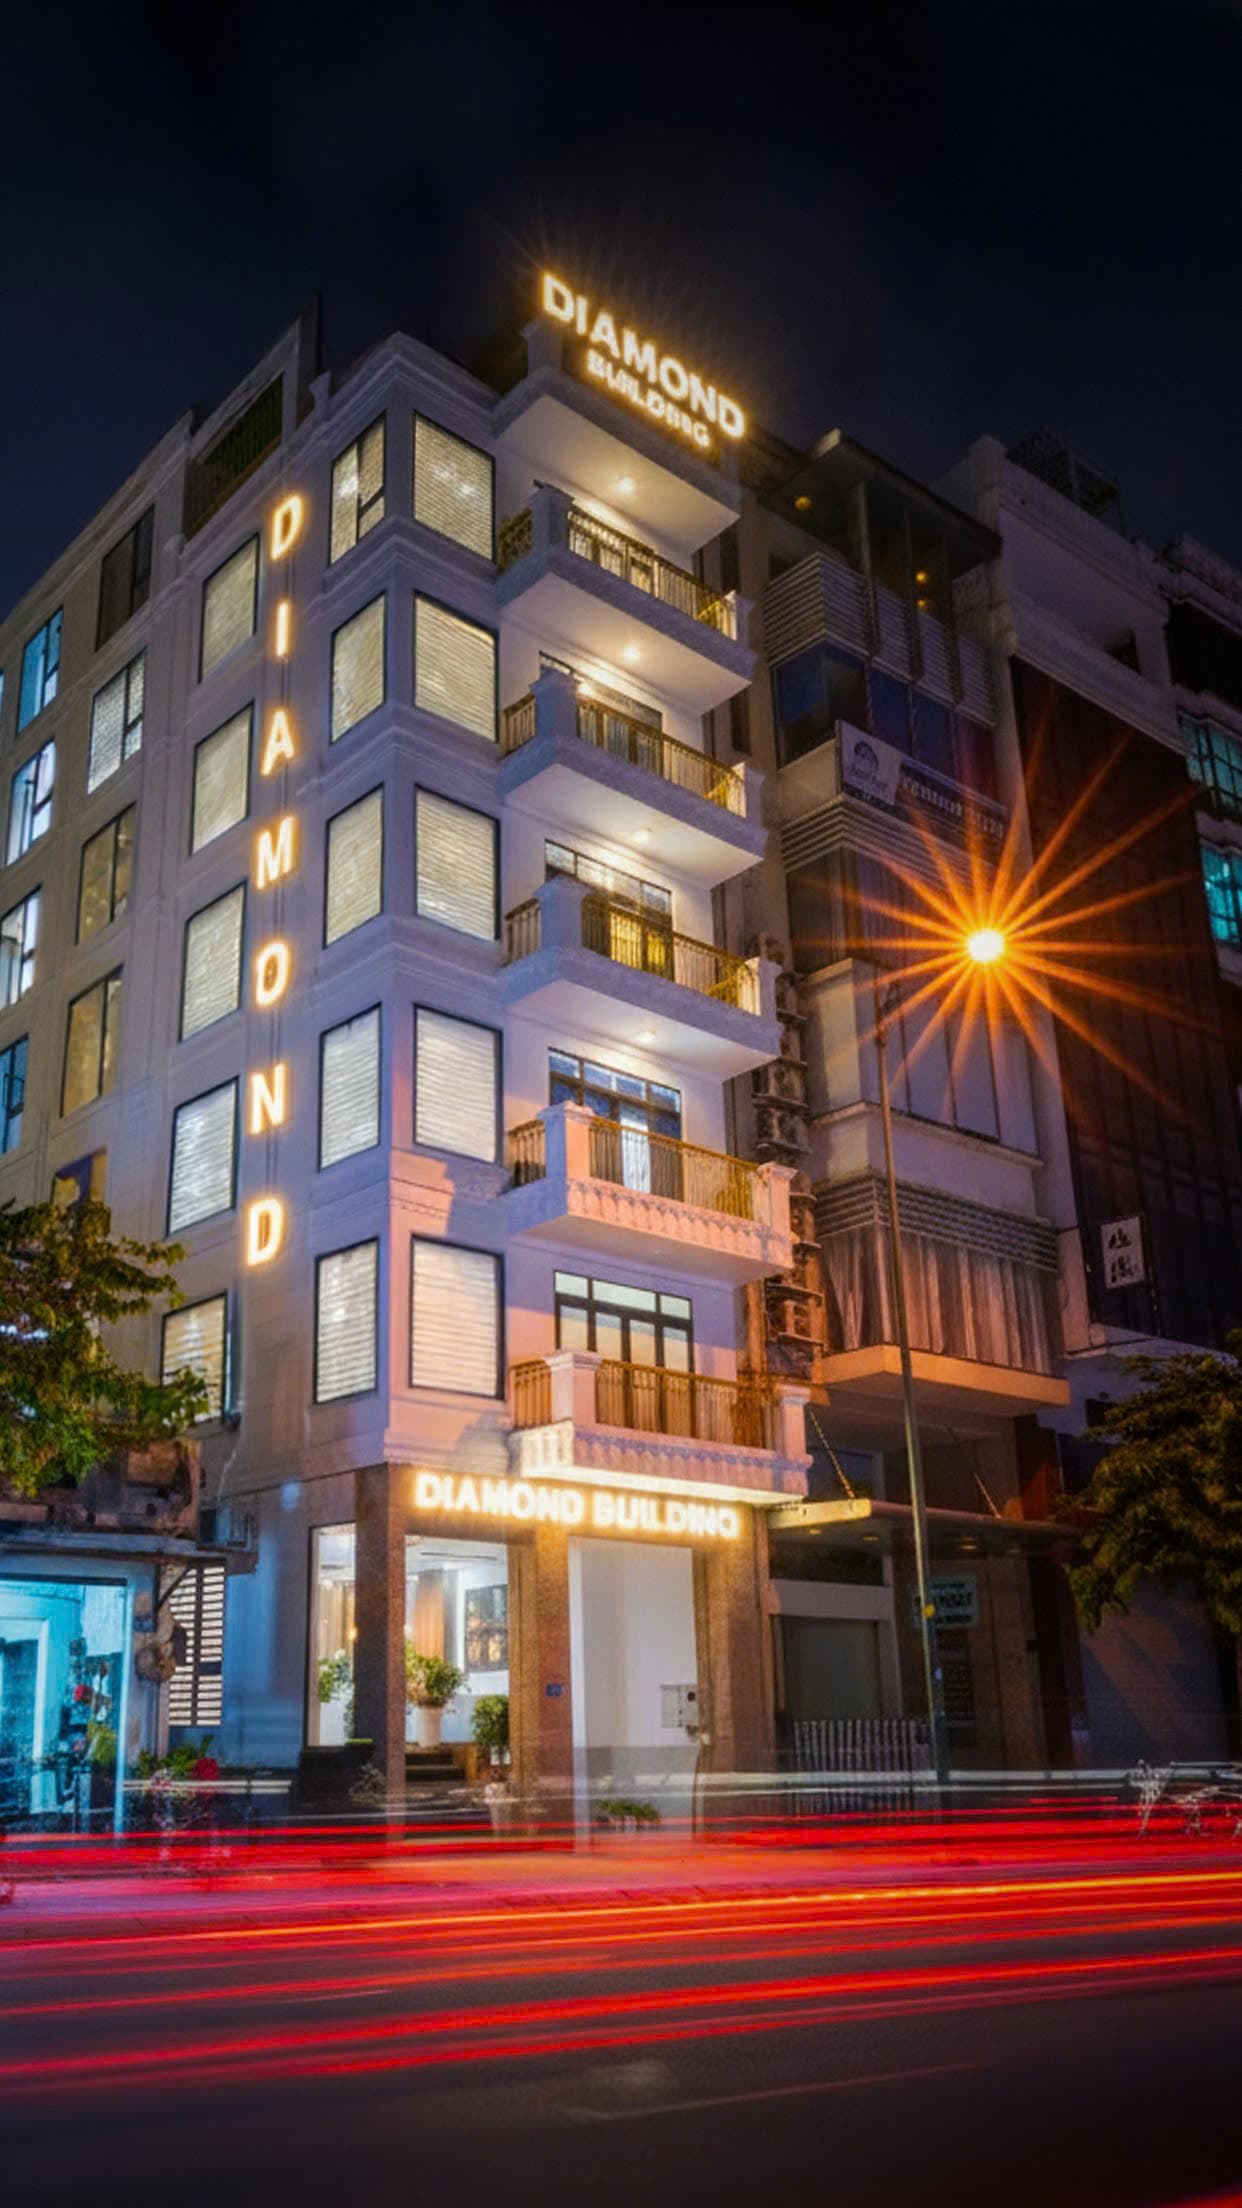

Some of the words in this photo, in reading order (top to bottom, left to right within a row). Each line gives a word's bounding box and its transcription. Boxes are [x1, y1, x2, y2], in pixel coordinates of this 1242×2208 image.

[543, 273, 745, 439] DIAMOND
[586, 349, 712, 448] BUILDING
[246, 495, 304, 1267] DIAMOND
[414, 1472, 585, 1526] DIAMOND
